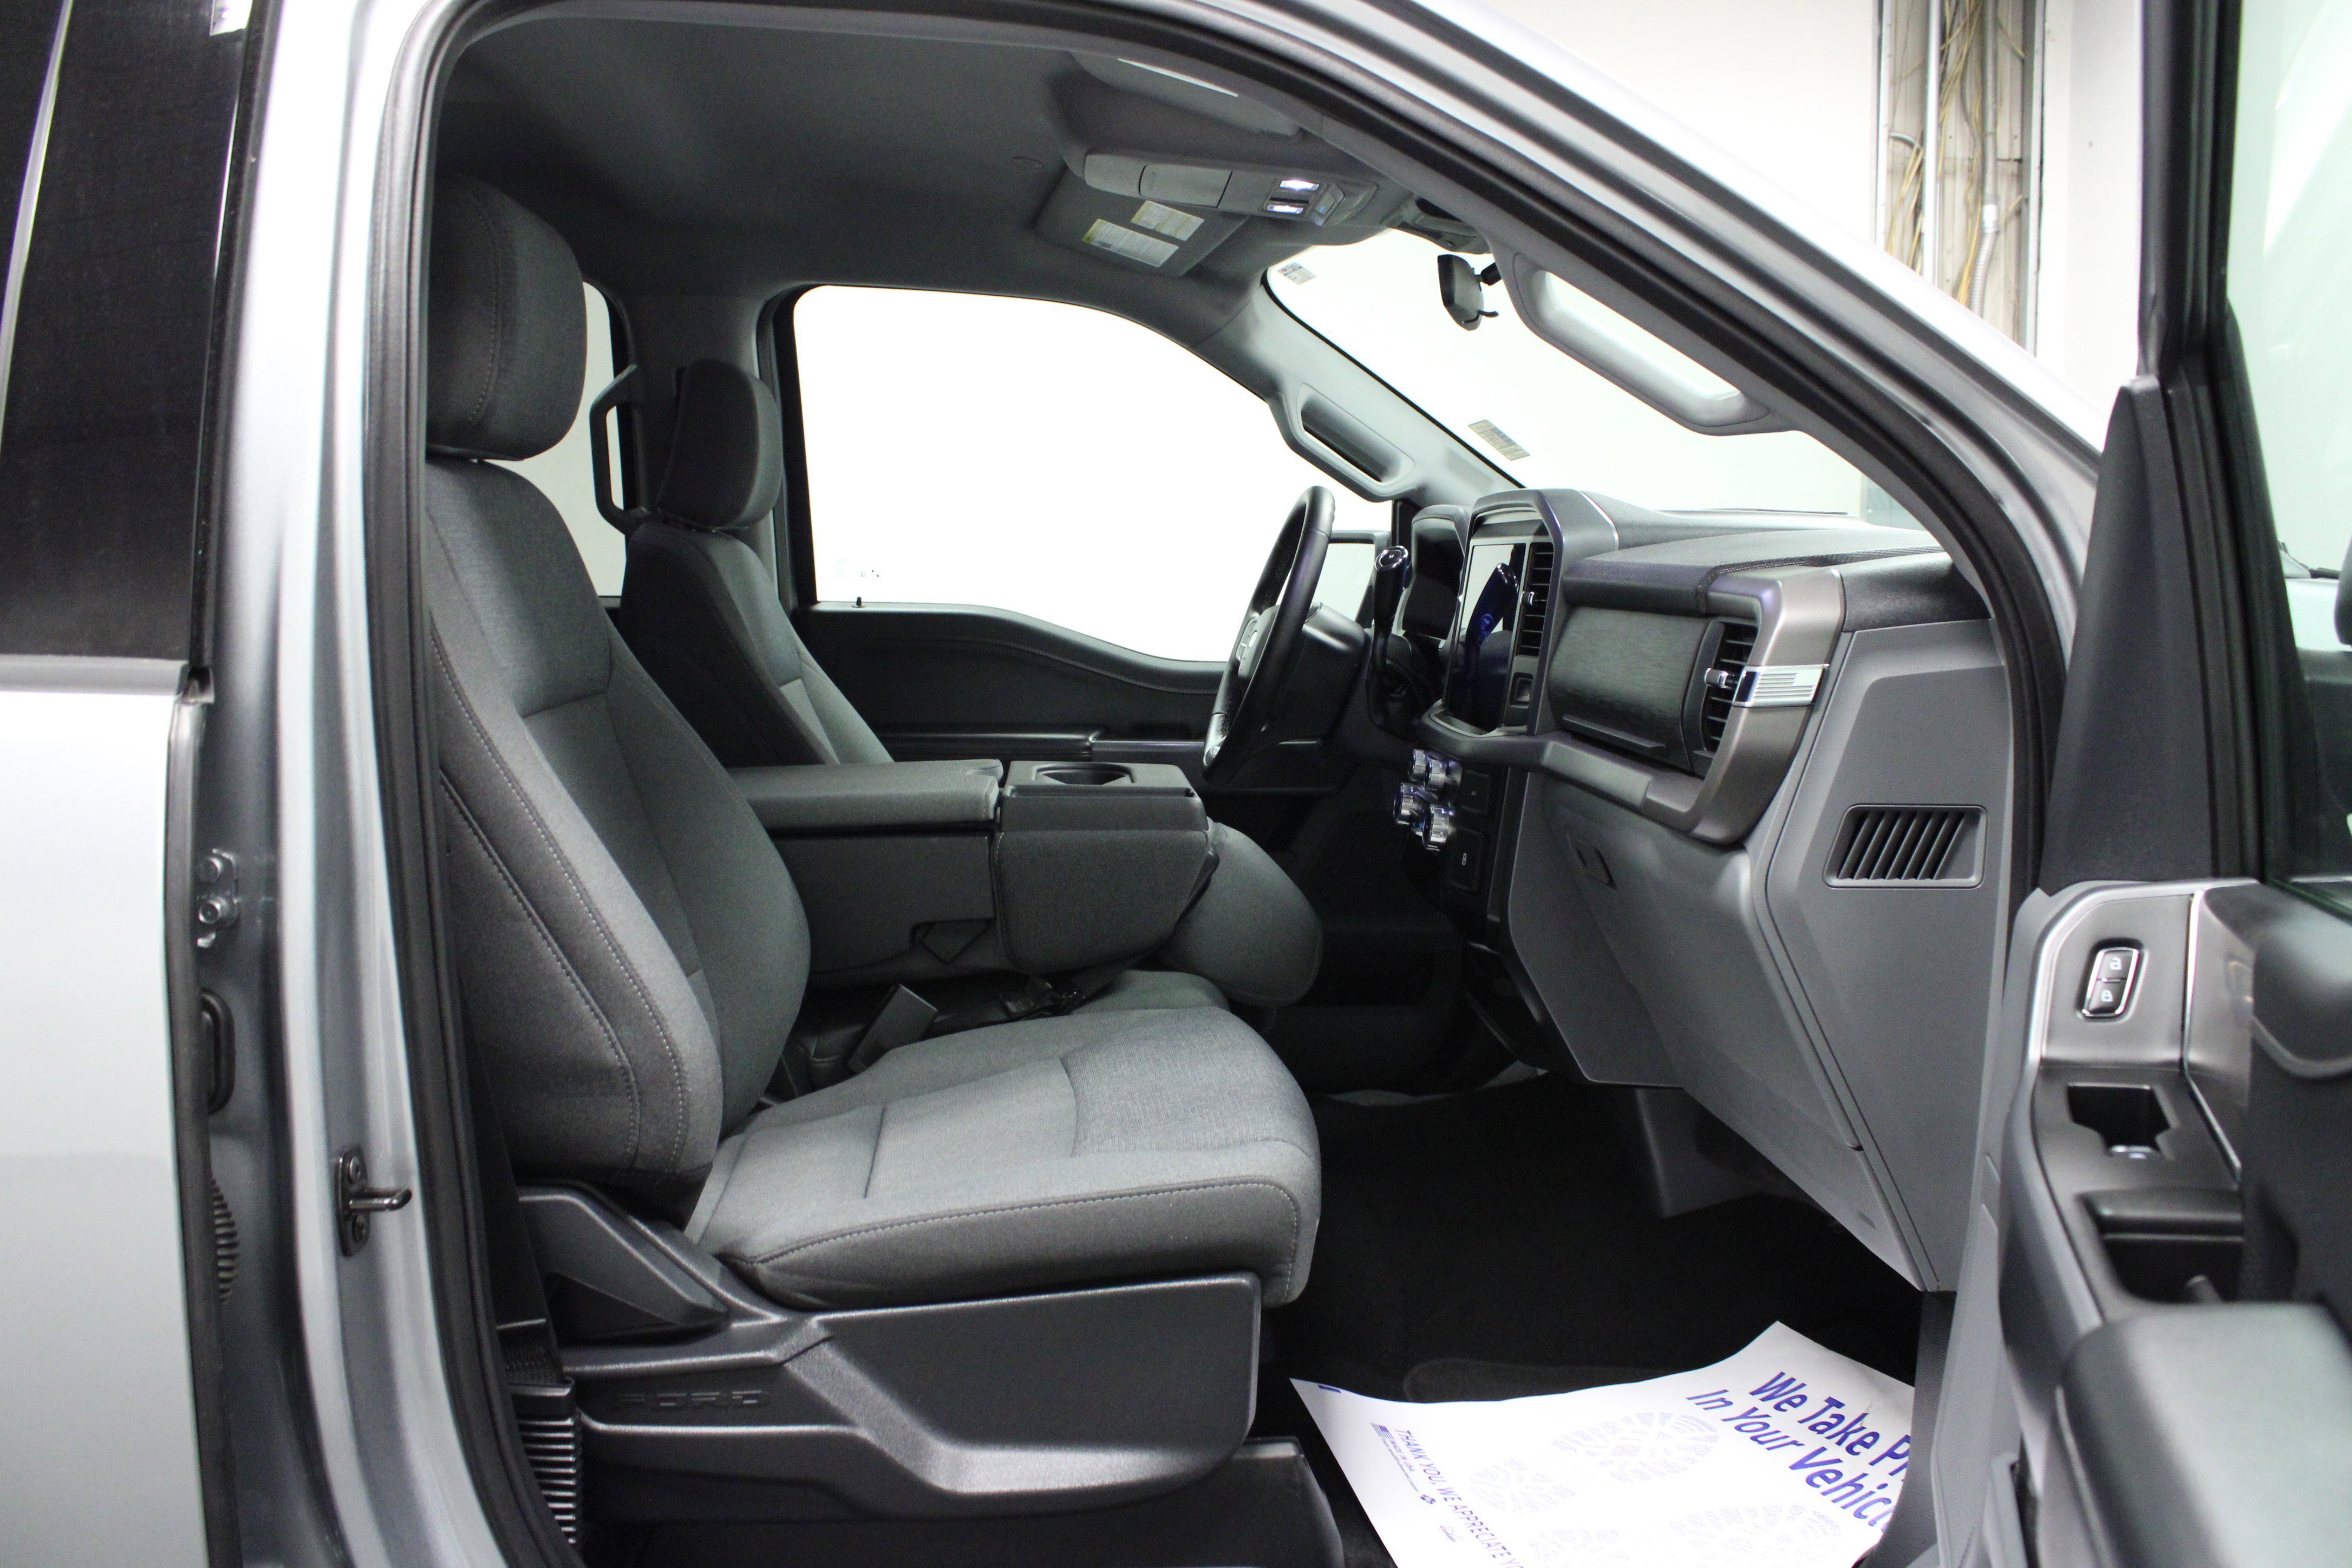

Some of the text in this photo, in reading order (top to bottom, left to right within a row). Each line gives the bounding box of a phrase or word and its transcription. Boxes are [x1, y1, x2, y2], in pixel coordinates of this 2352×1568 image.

[1686, 1389, 1895, 1533] In Your Vehicl
[1749, 1371, 1808, 1412] We
[1796, 1396, 1880, 1456] Take
[1394, 1429, 1431, 1461] THANK
[1419, 1463, 1447, 1485] YOU,
[1436, 1487, 1462, 1501] WE
[1449, 1504, 1511, 1558] APPRECIATE
